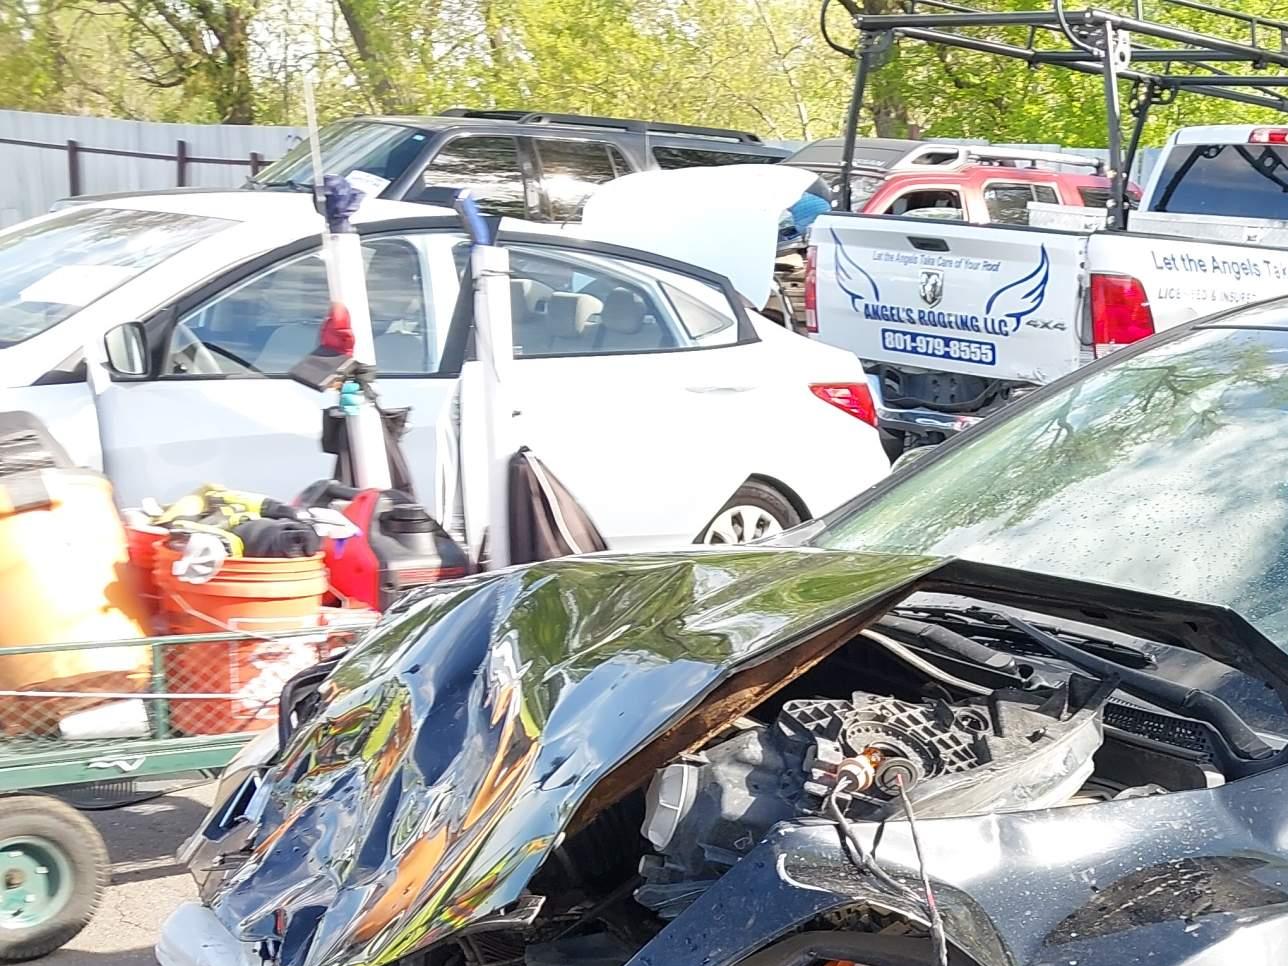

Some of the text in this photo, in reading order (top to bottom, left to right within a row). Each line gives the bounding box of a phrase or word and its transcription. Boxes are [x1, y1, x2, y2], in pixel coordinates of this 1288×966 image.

[982, 261, 1001, 272] Roof
[1151, 250, 1179, 272] Let
[1180, 253, 1208, 273] the
[1211, 255, 1262, 281] Angels
[863, 303, 1010, 337] ANGEL'S ROOFING LLC
[884, 331, 994, 363] 801-979-8555
